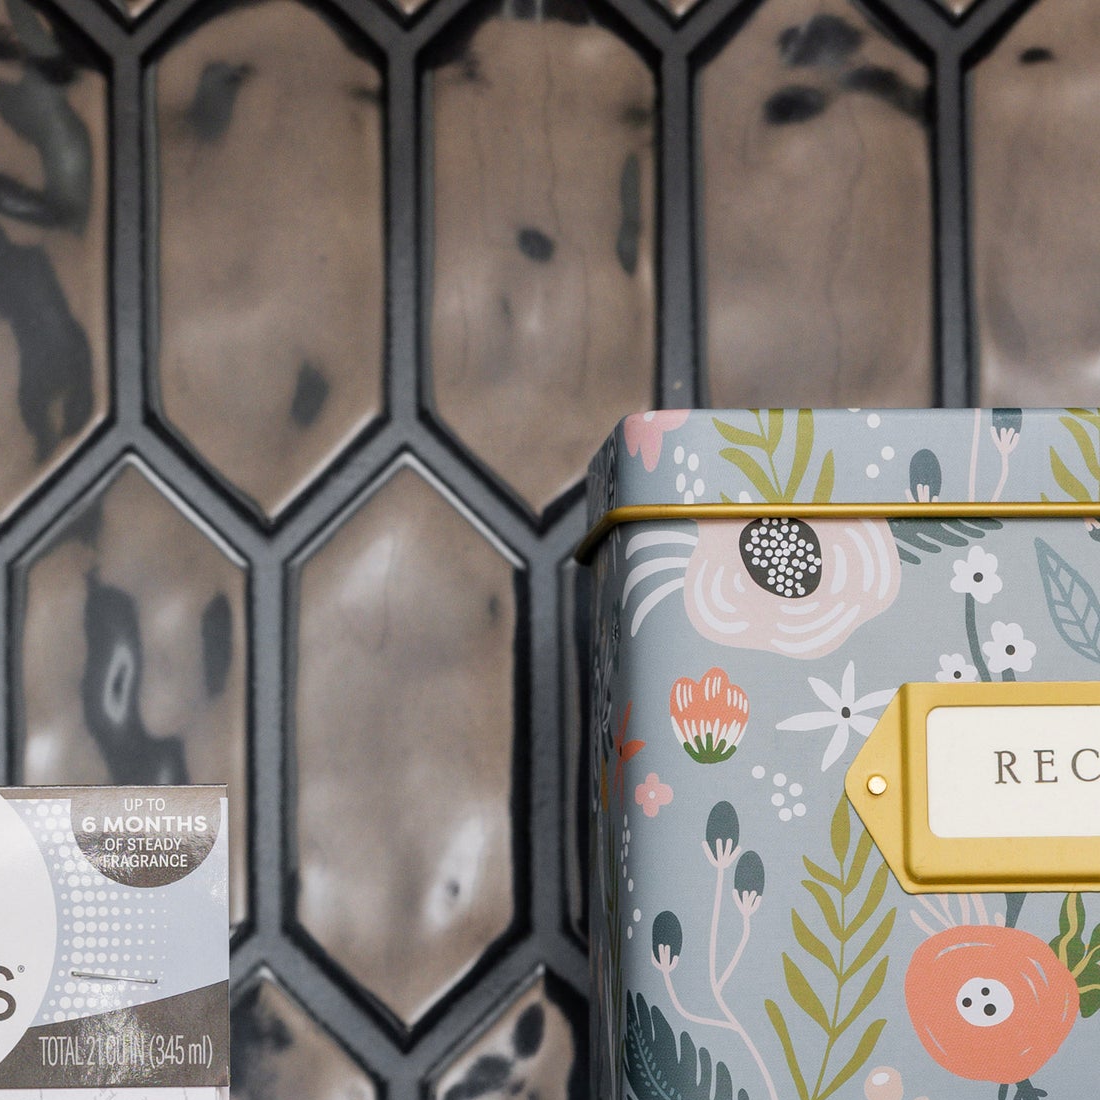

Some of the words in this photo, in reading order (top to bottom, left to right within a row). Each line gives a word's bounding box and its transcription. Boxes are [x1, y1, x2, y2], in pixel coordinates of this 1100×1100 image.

[124, 797, 143, 812] UP
[147, 797, 166, 812] TO
[81, 816, 97, 833] 6
[103, 815, 208, 833] MONTHS
[104, 837, 124, 851] OF
[127, 837, 182, 851] STEADY
[103, 854, 188, 868] FRAGRANCE
[38, 1035, 84, 1066] TOTAL
[86, 1035, 103, 1066] 21
[150, 1035, 185, 1069] (345
[188, 1035, 213, 1069] ml)
